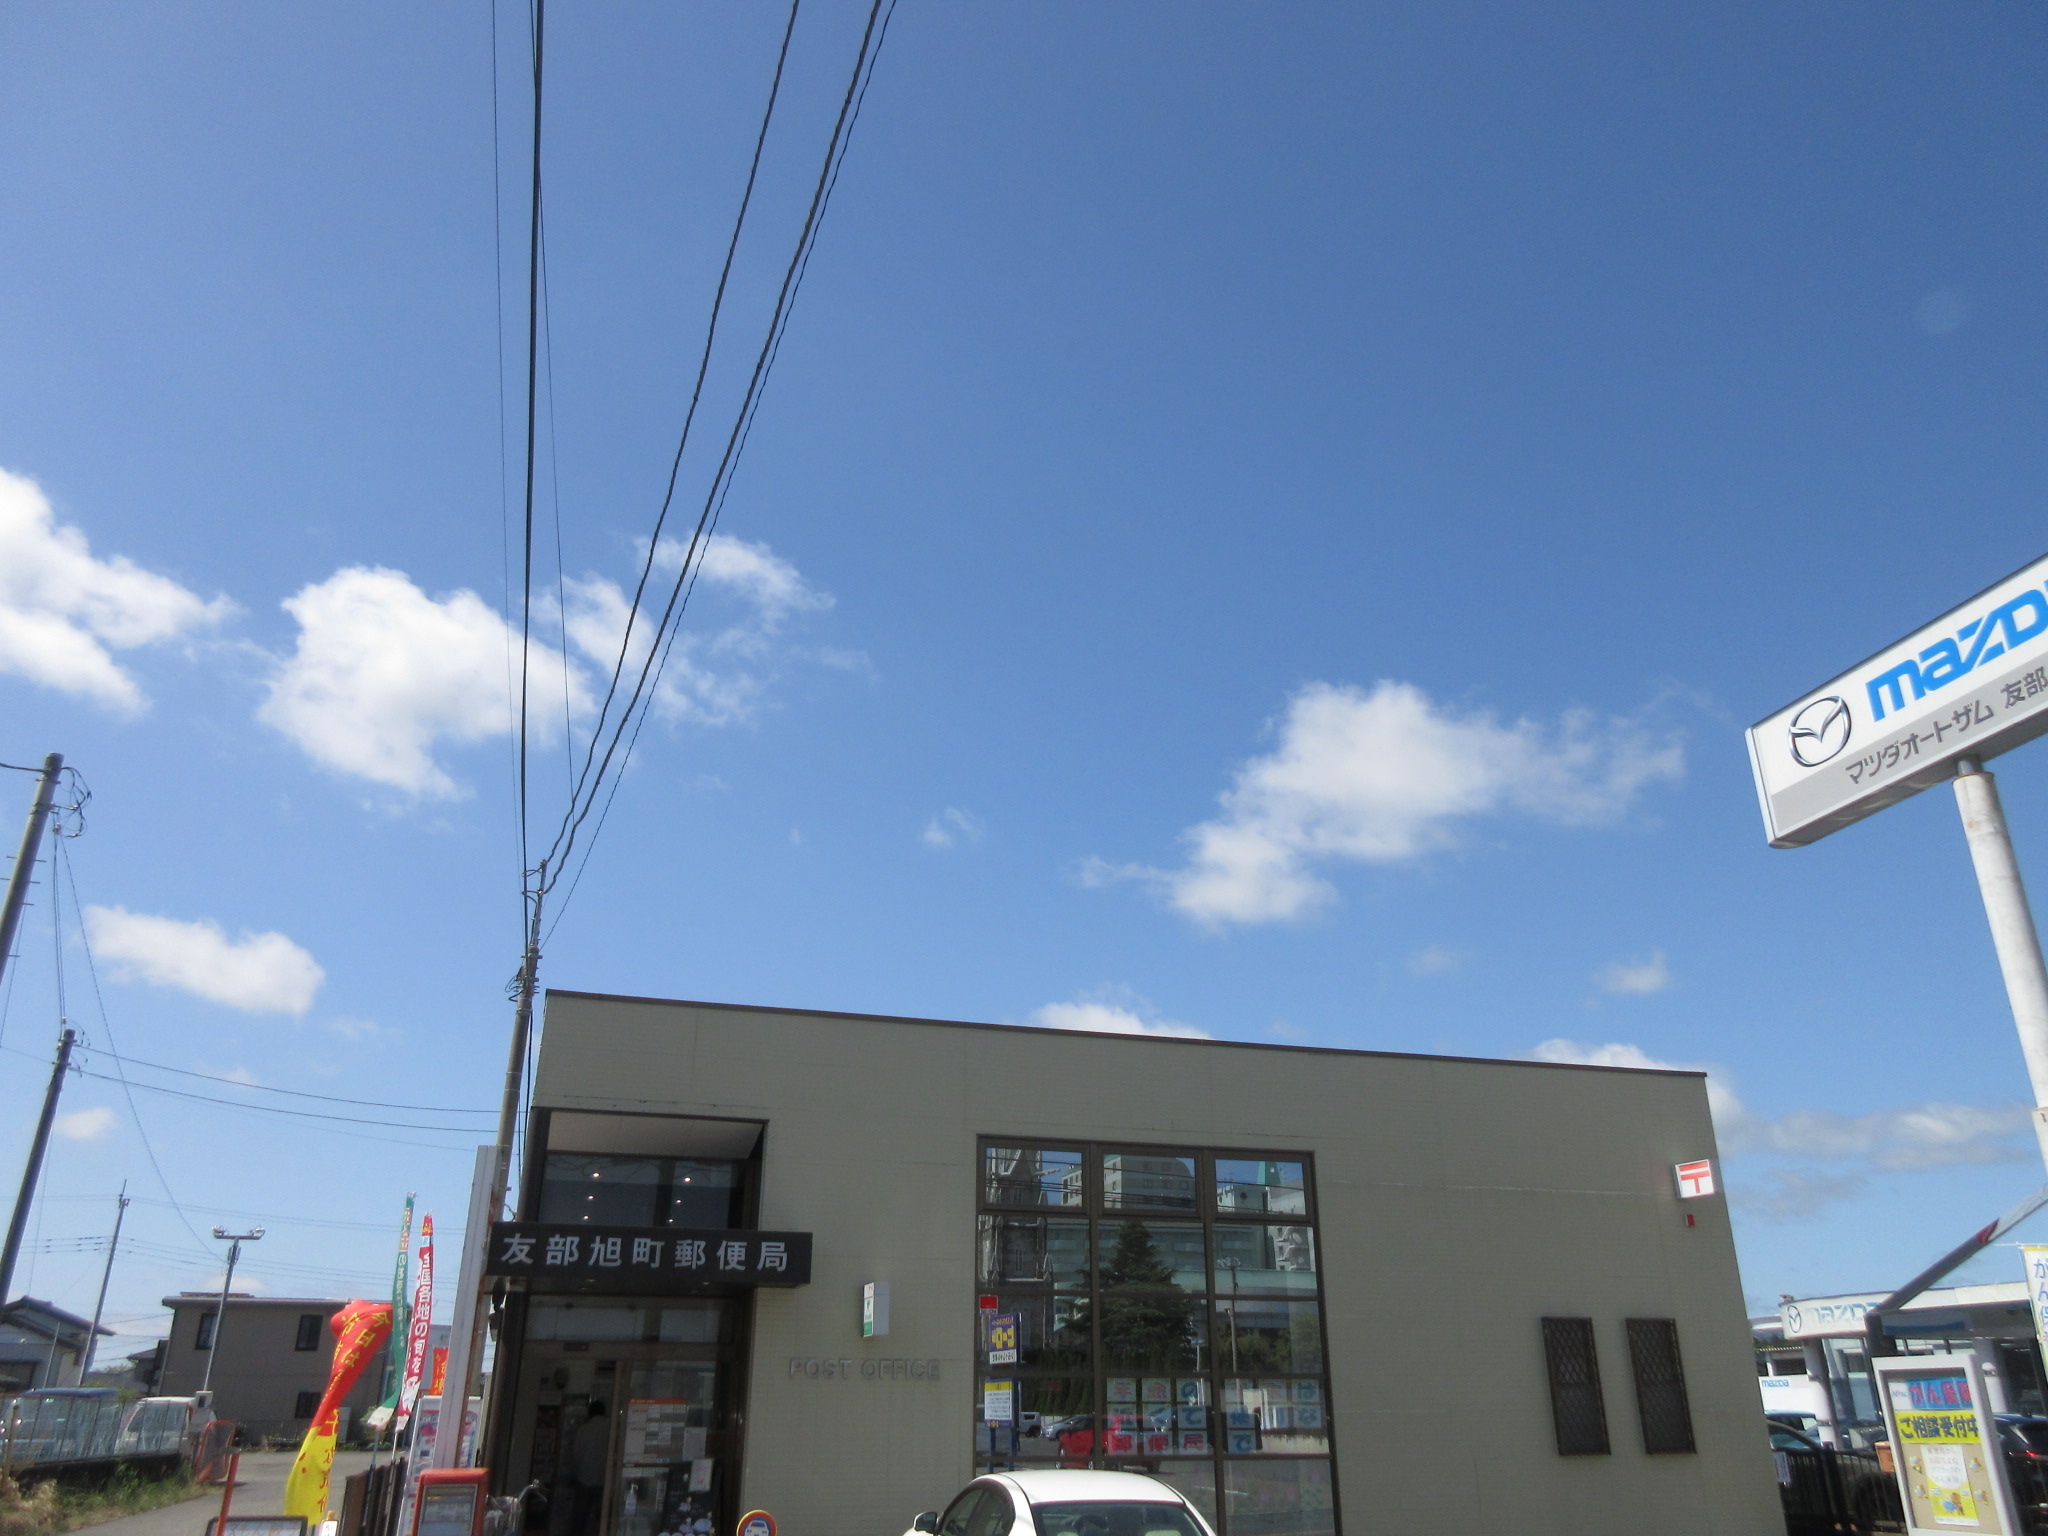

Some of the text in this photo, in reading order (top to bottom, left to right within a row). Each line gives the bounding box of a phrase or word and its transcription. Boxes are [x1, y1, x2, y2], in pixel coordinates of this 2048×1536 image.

[1866, 588, 2048, 722] mazd
[1845, 666, 2048, 784] マツダオートザム 友部
[501, 1233, 788, 1272] 友部旭町郵便局
[790, 1358, 941, 1381] POST OFFICE
